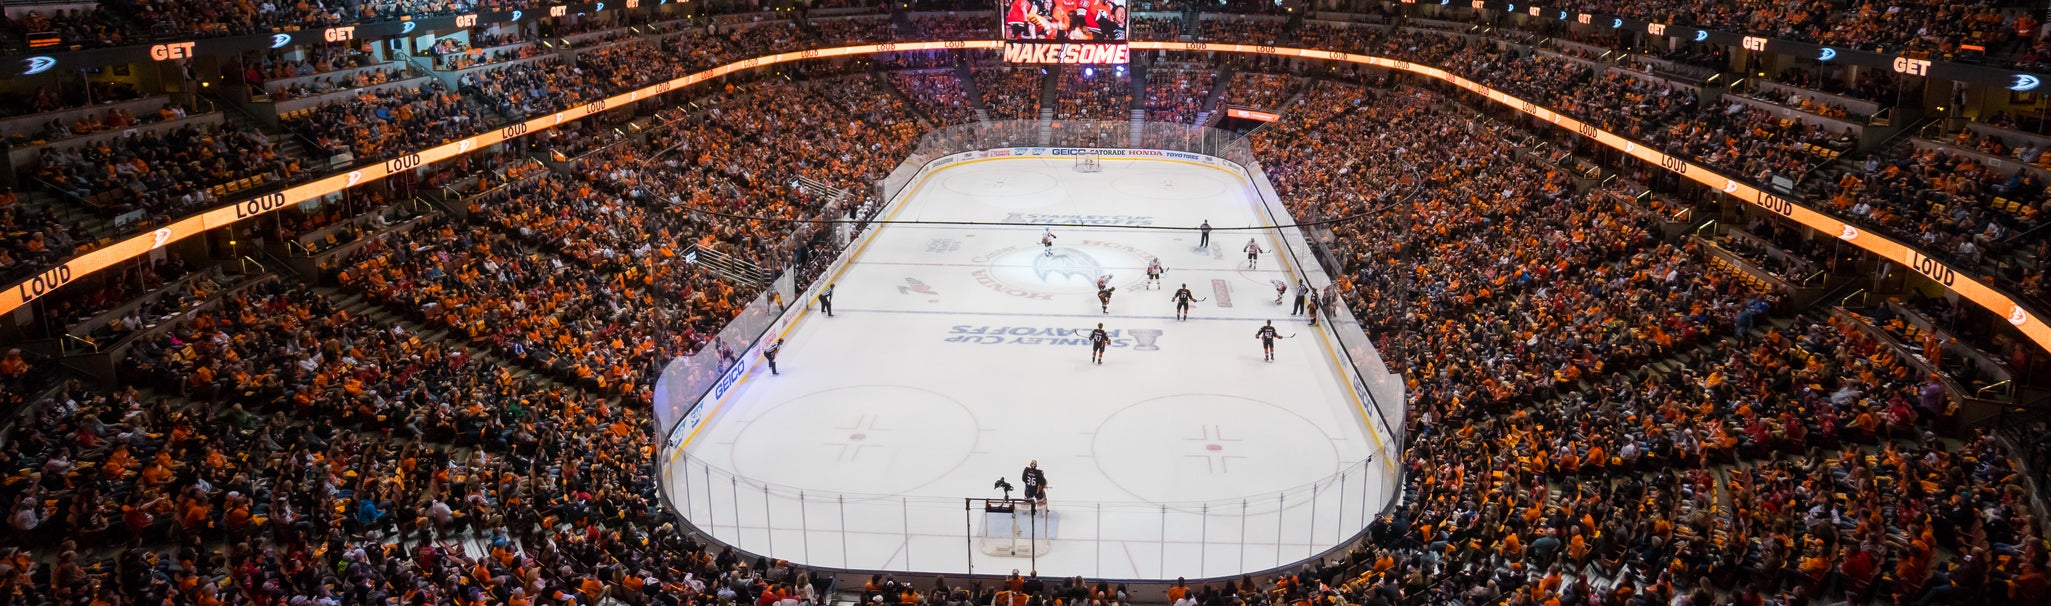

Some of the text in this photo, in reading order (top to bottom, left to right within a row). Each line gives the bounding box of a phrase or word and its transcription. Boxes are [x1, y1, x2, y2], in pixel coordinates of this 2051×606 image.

[550, 5, 567, 17] GET
[1529, 6, 1541, 17] GET
[456, 14, 478, 28] GET
[1578, 13, 1592, 25] GET
[324, 26, 355, 42] GET
[1648, 22, 1666, 36] GET
[876, 43, 896, 51] LOUD
[1186, 42, 1207, 50] LOUD
[1742, 36, 1768, 51] GET
[150, 41, 195, 62] GET
[1003, 43, 1127, 64] MAKE SOME
[1330, 52, 1348, 60] LOUD
[1394, 60, 1410, 70] LOUD
[1893, 56, 1932, 77] GET
[655, 81, 671, 94] LOUD
[586, 100, 606, 114] LOUD
[1522, 102, 1537, 115] LOUD
[502, 123, 528, 140] LOUD
[1578, 122, 1598, 139] LOUD
[1052, 148, 1086, 156] GEICO
[386, 154, 421, 175] LOUD
[1661, 155, 1687, 174] LOUD
[235, 192, 286, 219] LOUD
[1757, 191, 1793, 217] LOUD
[1912, 251, 1955, 287] LOUD
[19, 265, 71, 303] LOUD
[971, 268, 1054, 301] HONDA
[944, 335, 1003, 345] CUP
[715, 360, 745, 400] GEICO
[1353, 374, 1373, 418] GEICO
[1026, 476, 1036, 486] 36
